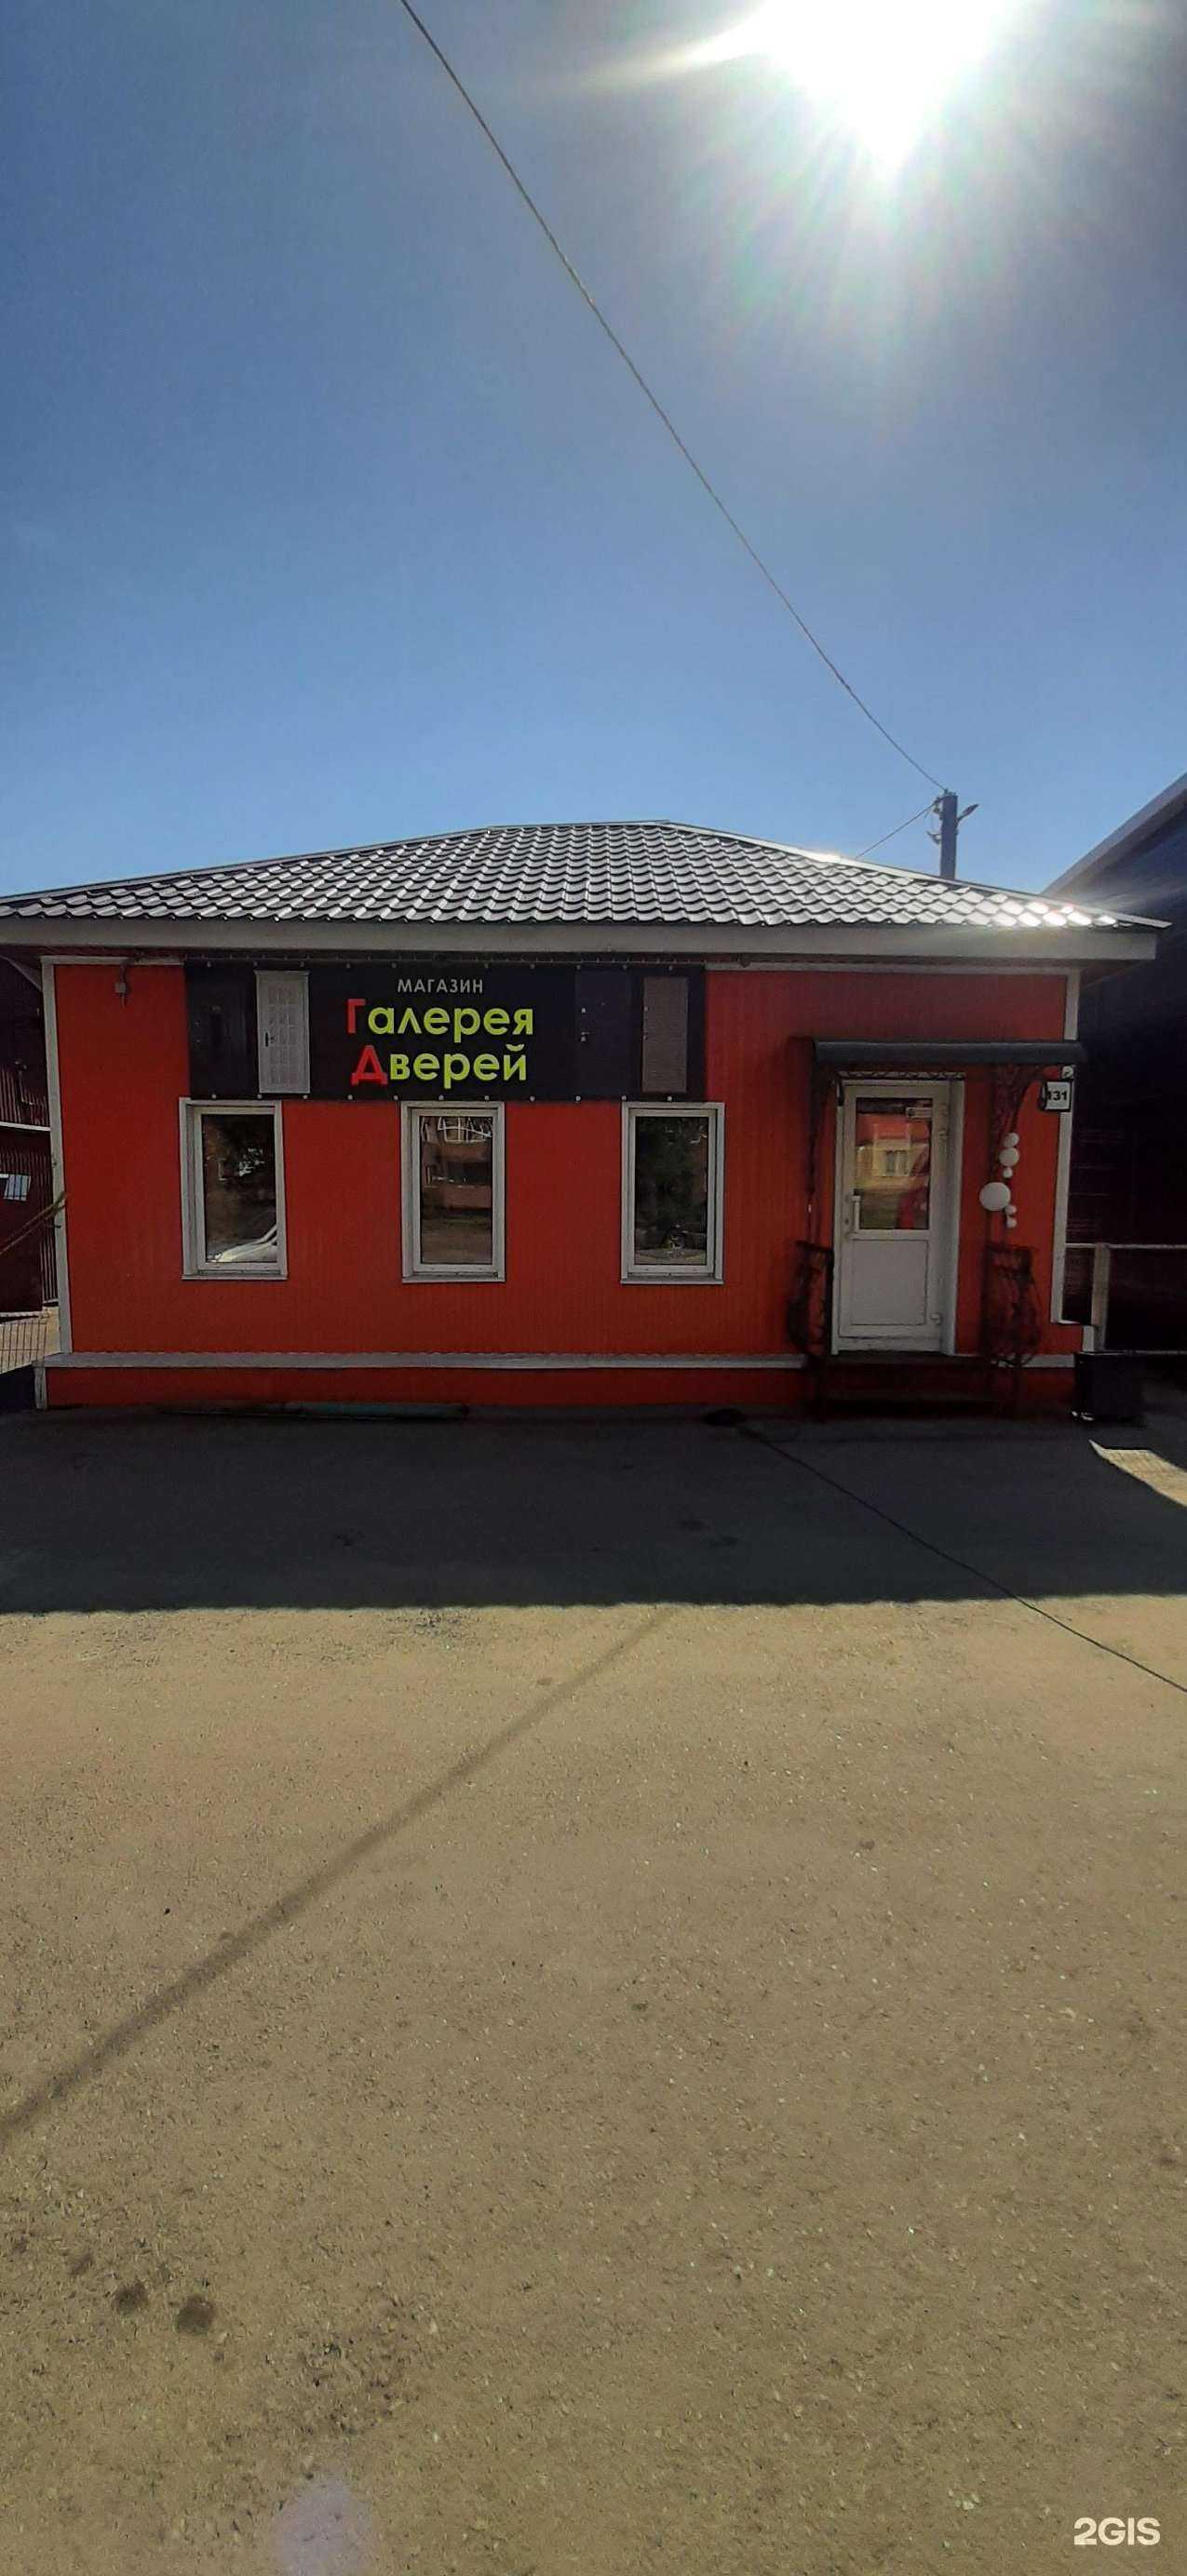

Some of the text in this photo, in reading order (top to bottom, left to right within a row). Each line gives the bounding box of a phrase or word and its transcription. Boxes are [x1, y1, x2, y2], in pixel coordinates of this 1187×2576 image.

[397, 978, 484, 994] МАГАЗИН
[347, 999, 533, 1042] Галерея
[351, 1043, 528, 1089] Дверей
